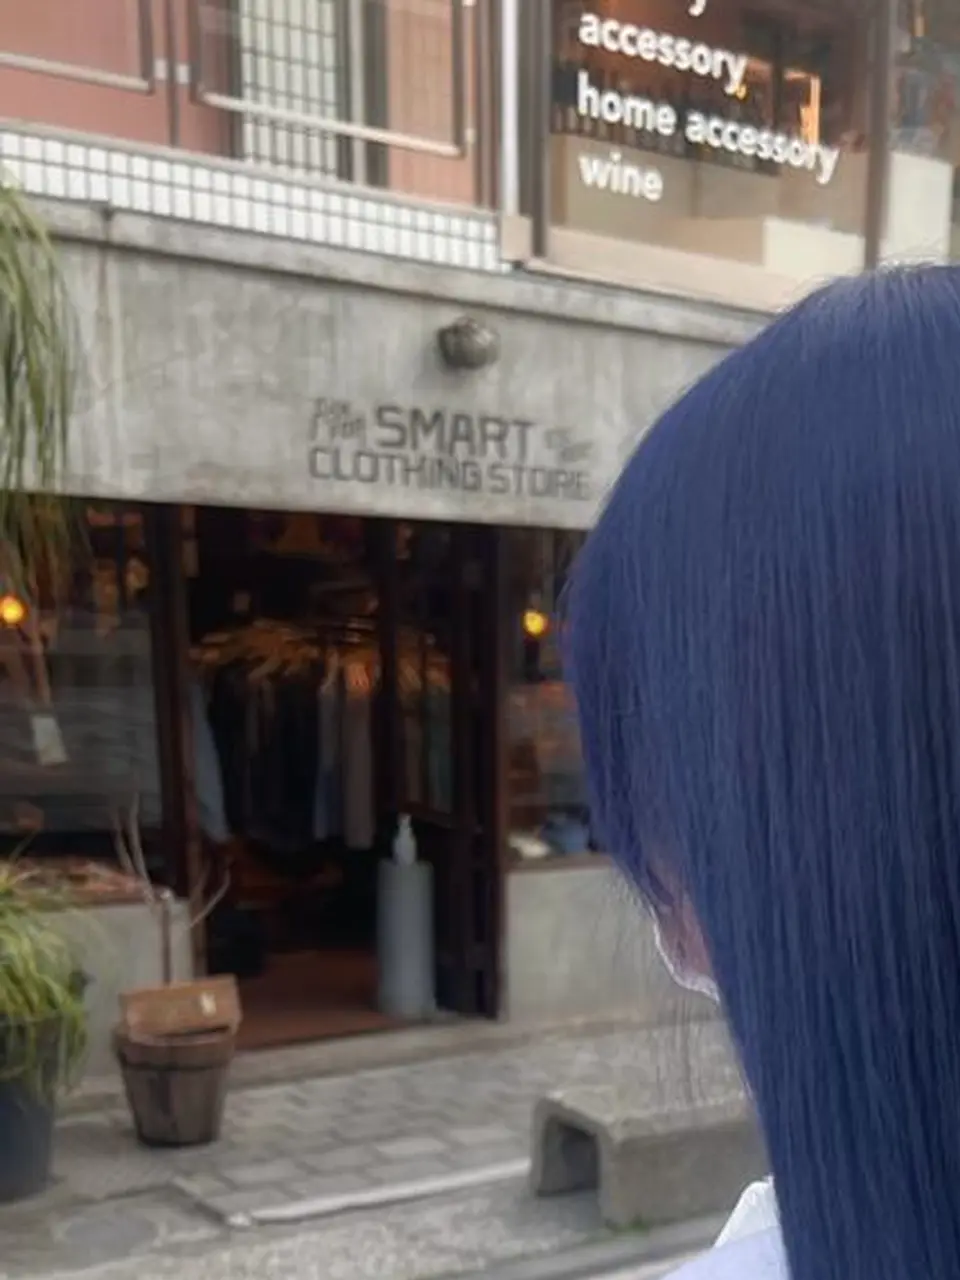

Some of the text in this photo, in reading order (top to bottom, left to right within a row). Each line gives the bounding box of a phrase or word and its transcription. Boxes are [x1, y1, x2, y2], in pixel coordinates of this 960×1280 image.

[578, 12, 747, 96] accessory
[577, 70, 840, 185] home accessory
[578, 152, 663, 201] wine
[375, 405, 535, 463] SMART
[308, 446, 592, 500] CLOTHING STORE
